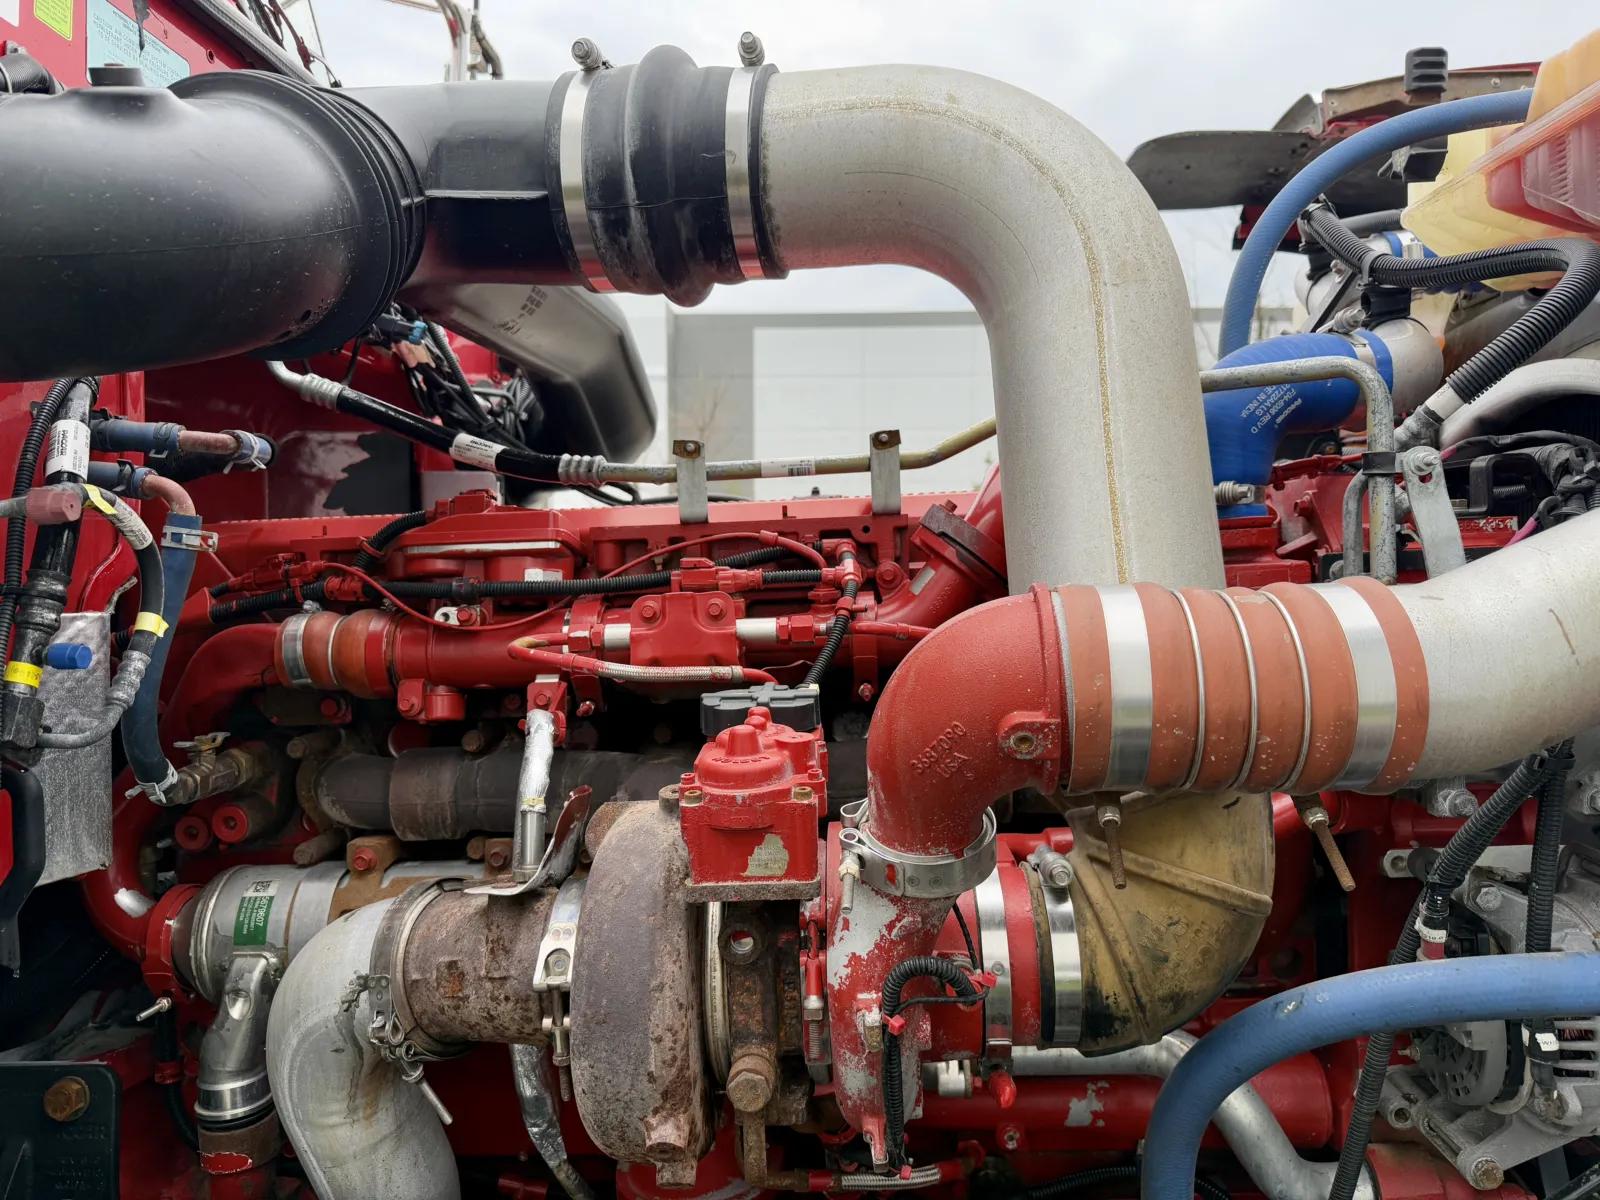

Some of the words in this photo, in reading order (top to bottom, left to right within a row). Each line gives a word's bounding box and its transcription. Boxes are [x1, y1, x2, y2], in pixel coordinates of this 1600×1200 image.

[60, 430, 69, 456] PACCAR
[910, 721, 966, 773] 3687090
[936, 751, 971, 778] USA
